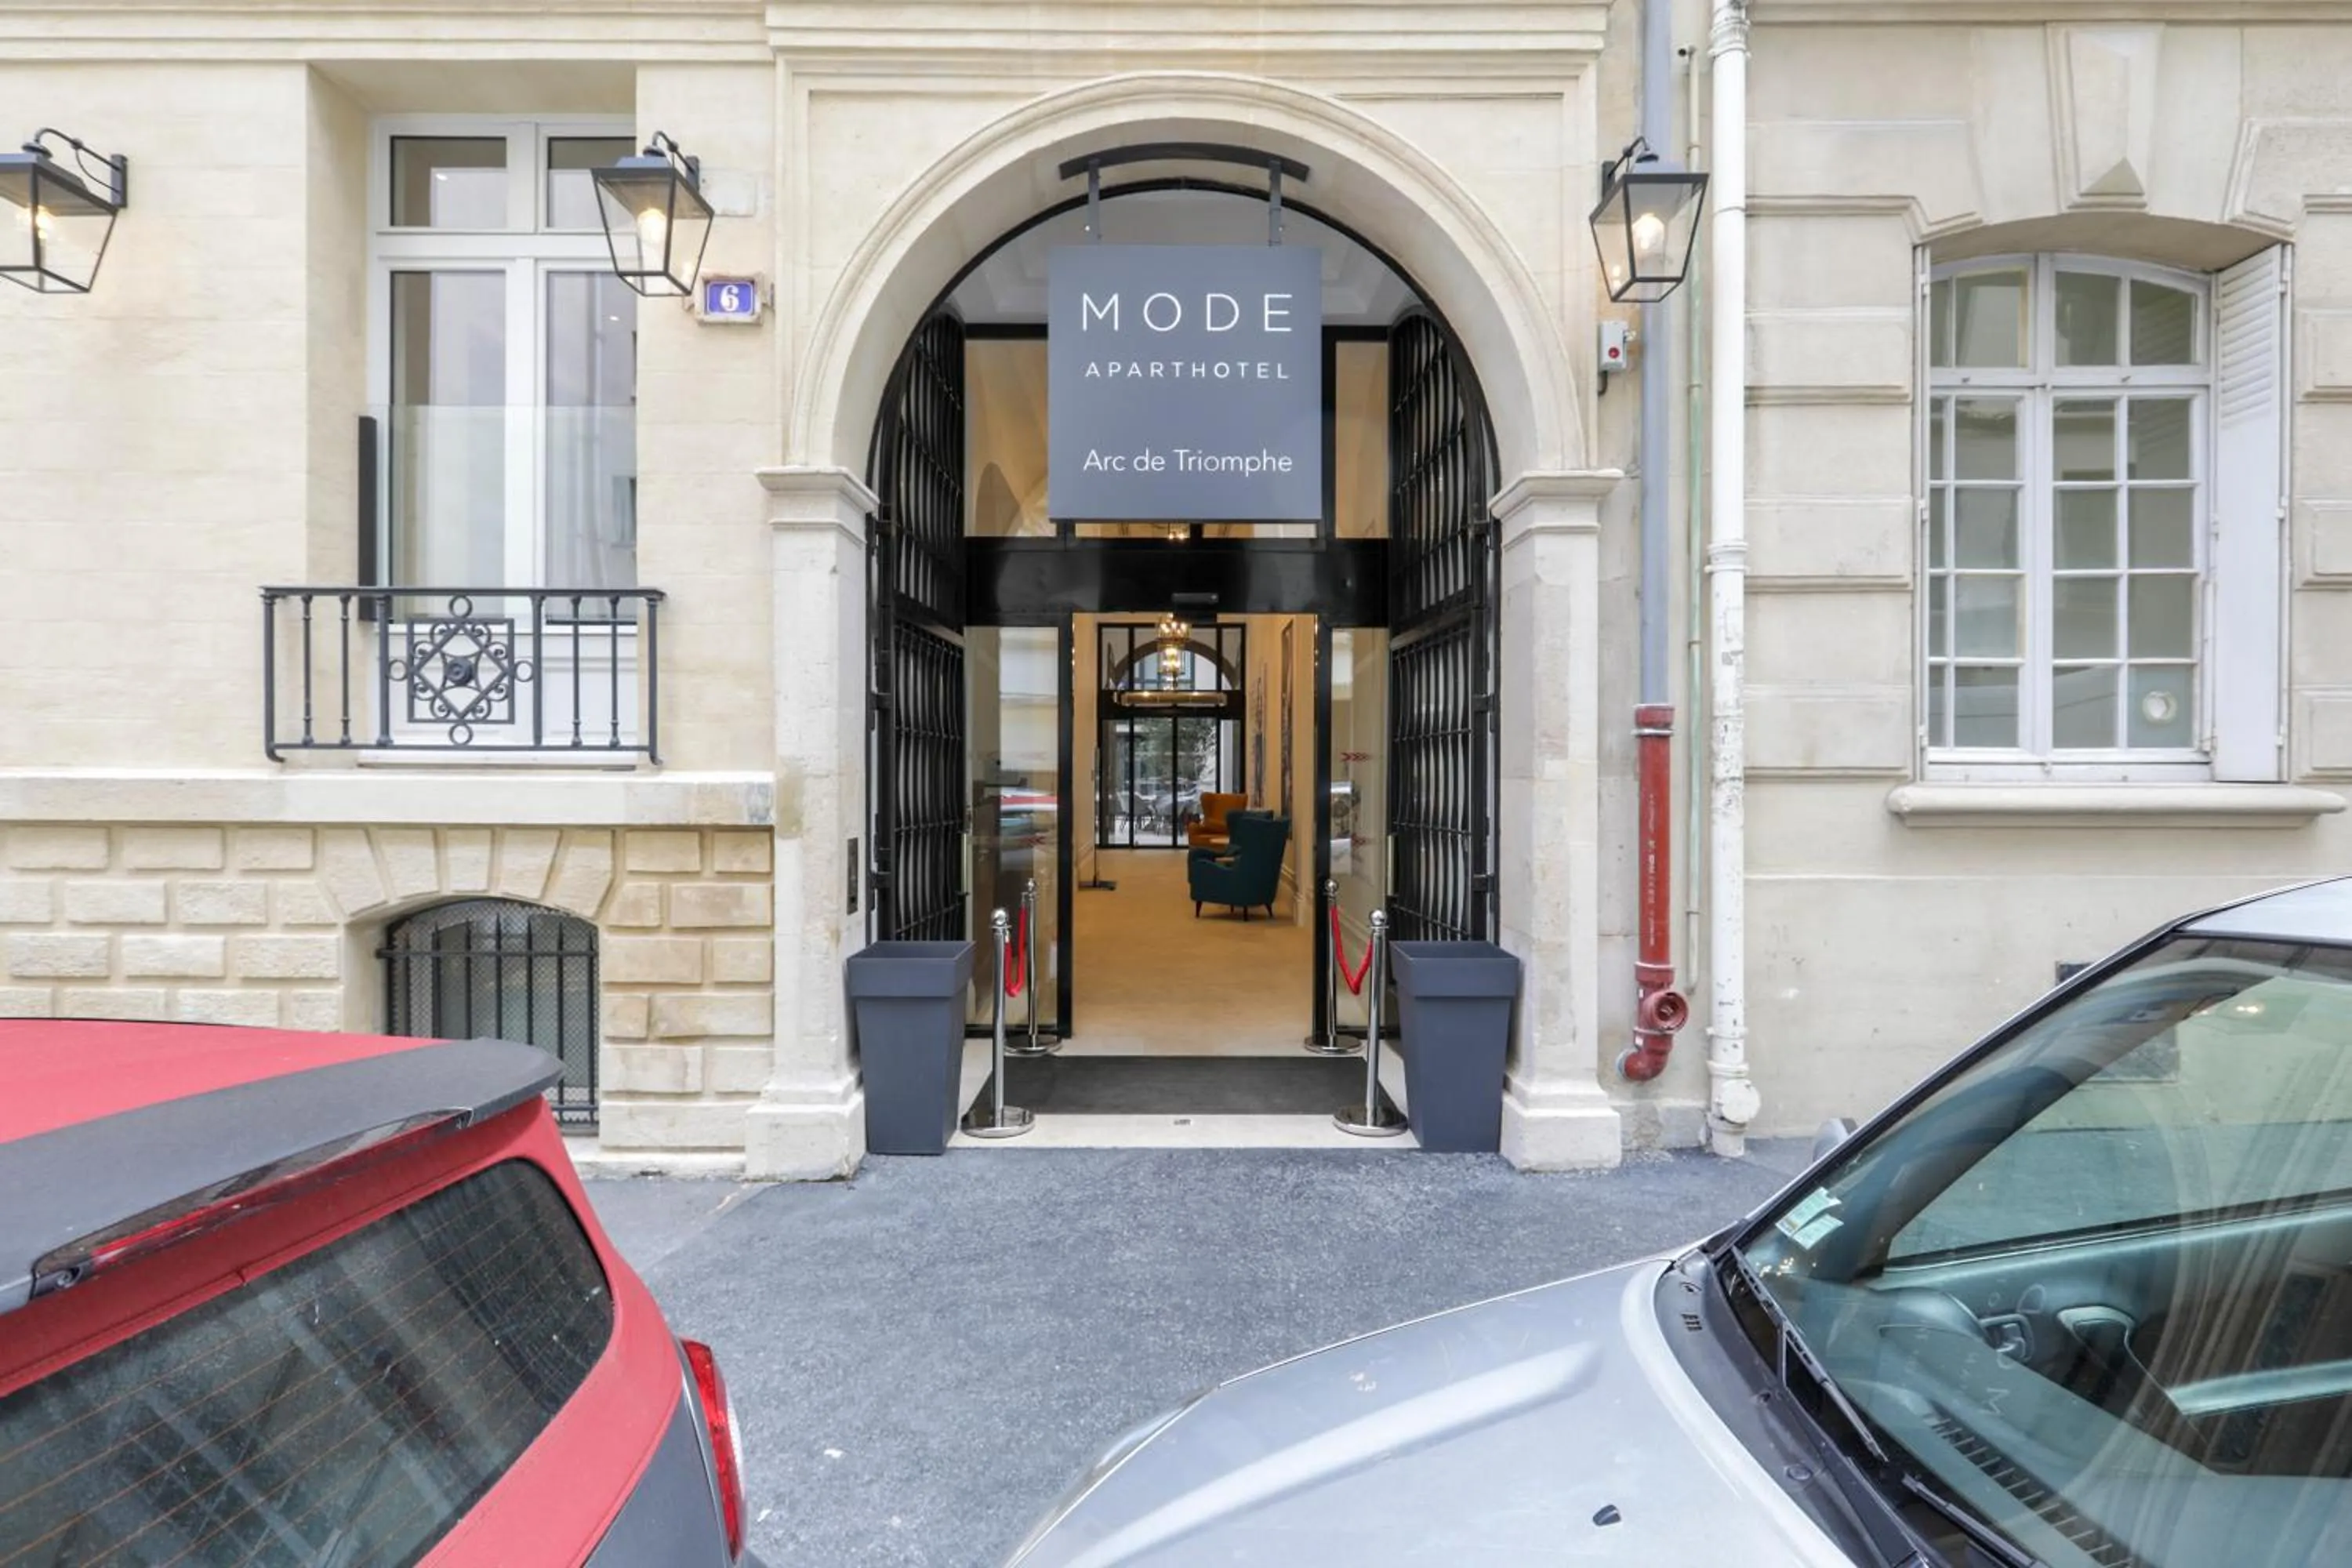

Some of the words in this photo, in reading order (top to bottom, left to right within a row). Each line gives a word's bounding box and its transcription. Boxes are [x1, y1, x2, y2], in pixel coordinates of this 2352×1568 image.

[720, 284, 739, 312] 6
[1082, 292, 1293, 332] MODE
[1084, 361, 1290, 379] APARTHOTEL
[1083, 448, 1126, 472] Arc
[1133, 448, 1167, 472] de
[1172, 448, 1293, 477] Triomphe
